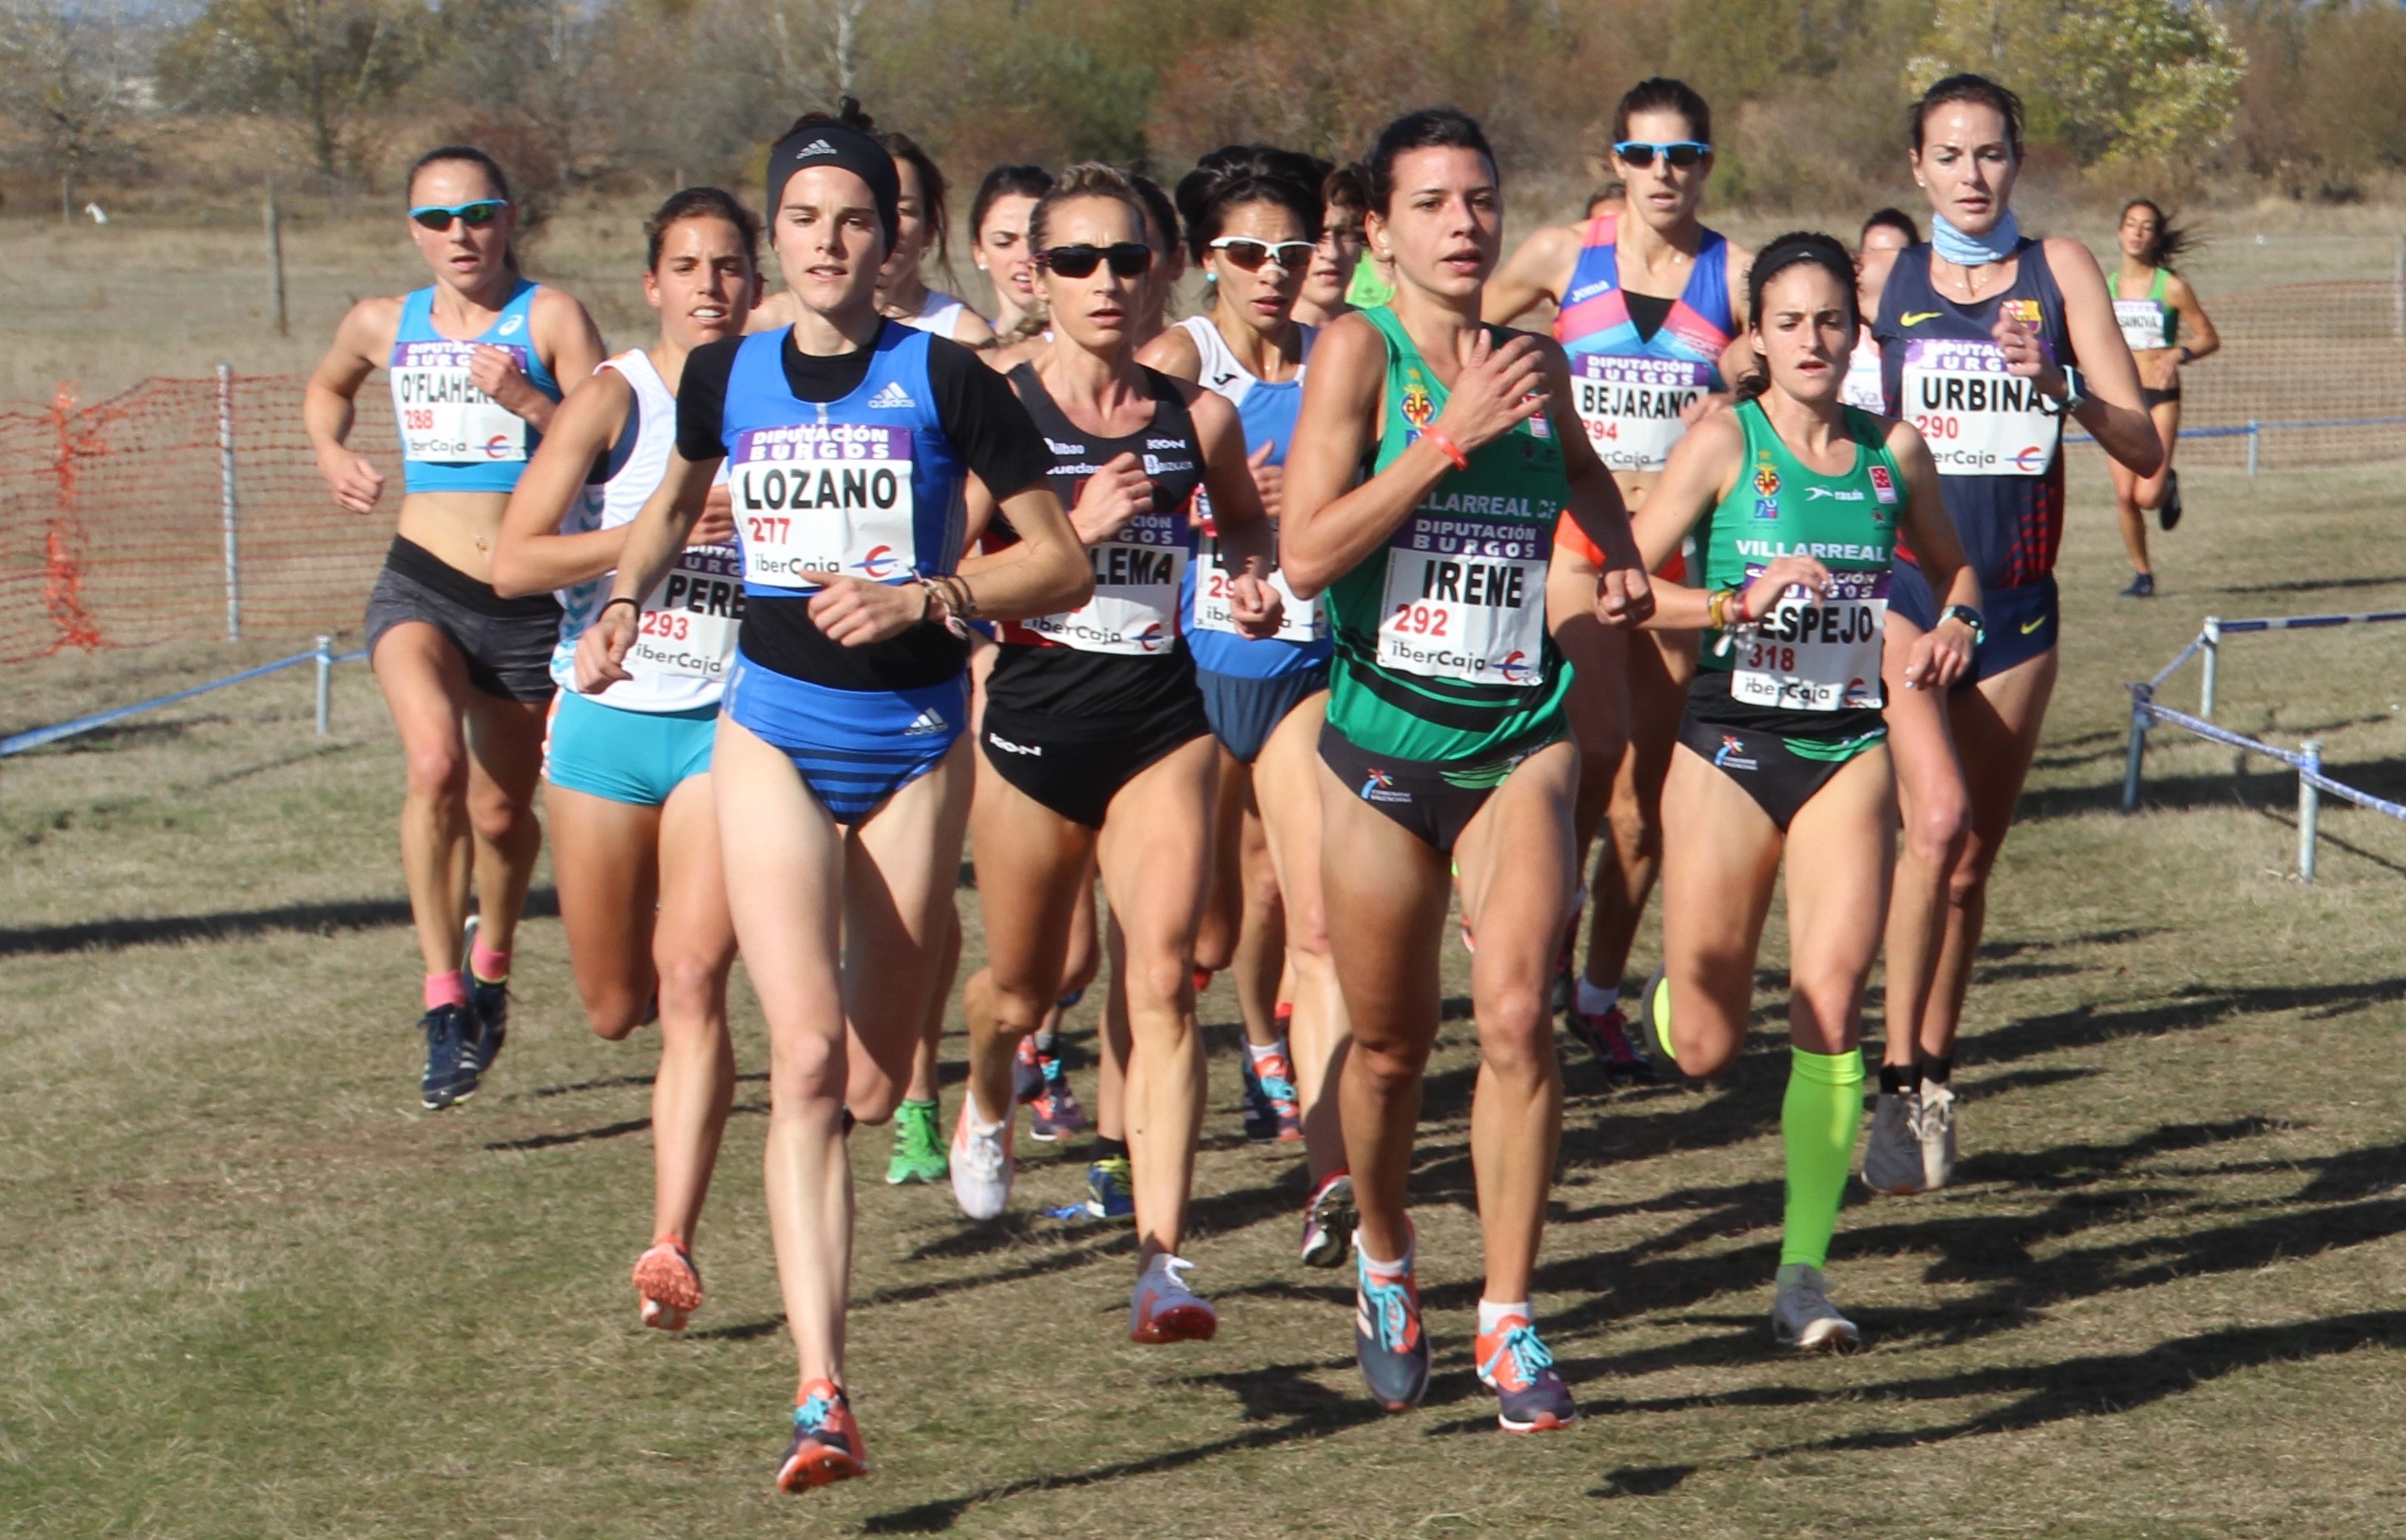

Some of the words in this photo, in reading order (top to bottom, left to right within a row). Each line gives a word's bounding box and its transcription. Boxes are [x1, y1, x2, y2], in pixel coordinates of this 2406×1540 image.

[407, 354, 470, 367] BURG
[1923, 342, 2005, 356] DIPUTAC
[1587, 355, 1695, 373] DIPUTACIÓN
[1922, 355, 2001, 371] BURG
[1586, 367, 1694, 386] BURGOS
[868, 399, 916, 408] adidas
[1922, 377, 2043, 412] URBINA
[405, 409, 434, 429] 288
[1915, 415, 1959, 439] 290
[753, 425, 889, 445] DIPUTACIÓN
[750, 442, 889, 461] BURGOS
[1599, 450, 1650, 467] rCaja
[1934, 450, 1996, 468] erCaja
[744, 468, 897, 510] LOZANO
[1415, 493, 1532, 518] LARREAL
[748, 517, 791, 544] 277
[1119, 528, 1173, 544] GOS
[1415, 518, 1537, 541] DIPUTACIÓN
[1413, 534, 1535, 558] BURGOS
[1735, 540, 1886, 561] VILLARREAL
[755, 553, 839, 574] iberCaja
[1209, 576, 1235, 599] 29
[1422, 560, 1525, 608] IRENE
[641, 610, 689, 641] 293
[1032, 618, 1122, 644] iberCaja
[1394, 604, 1448, 637] 292
[1757, 606, 1874, 644] ESPEJO
[635, 643, 722, 675] iberCaja
[1392, 641, 1487, 673] iberCaja
[1748, 643, 1795, 672] 318
[1745, 676, 1830, 703] iberCaja
